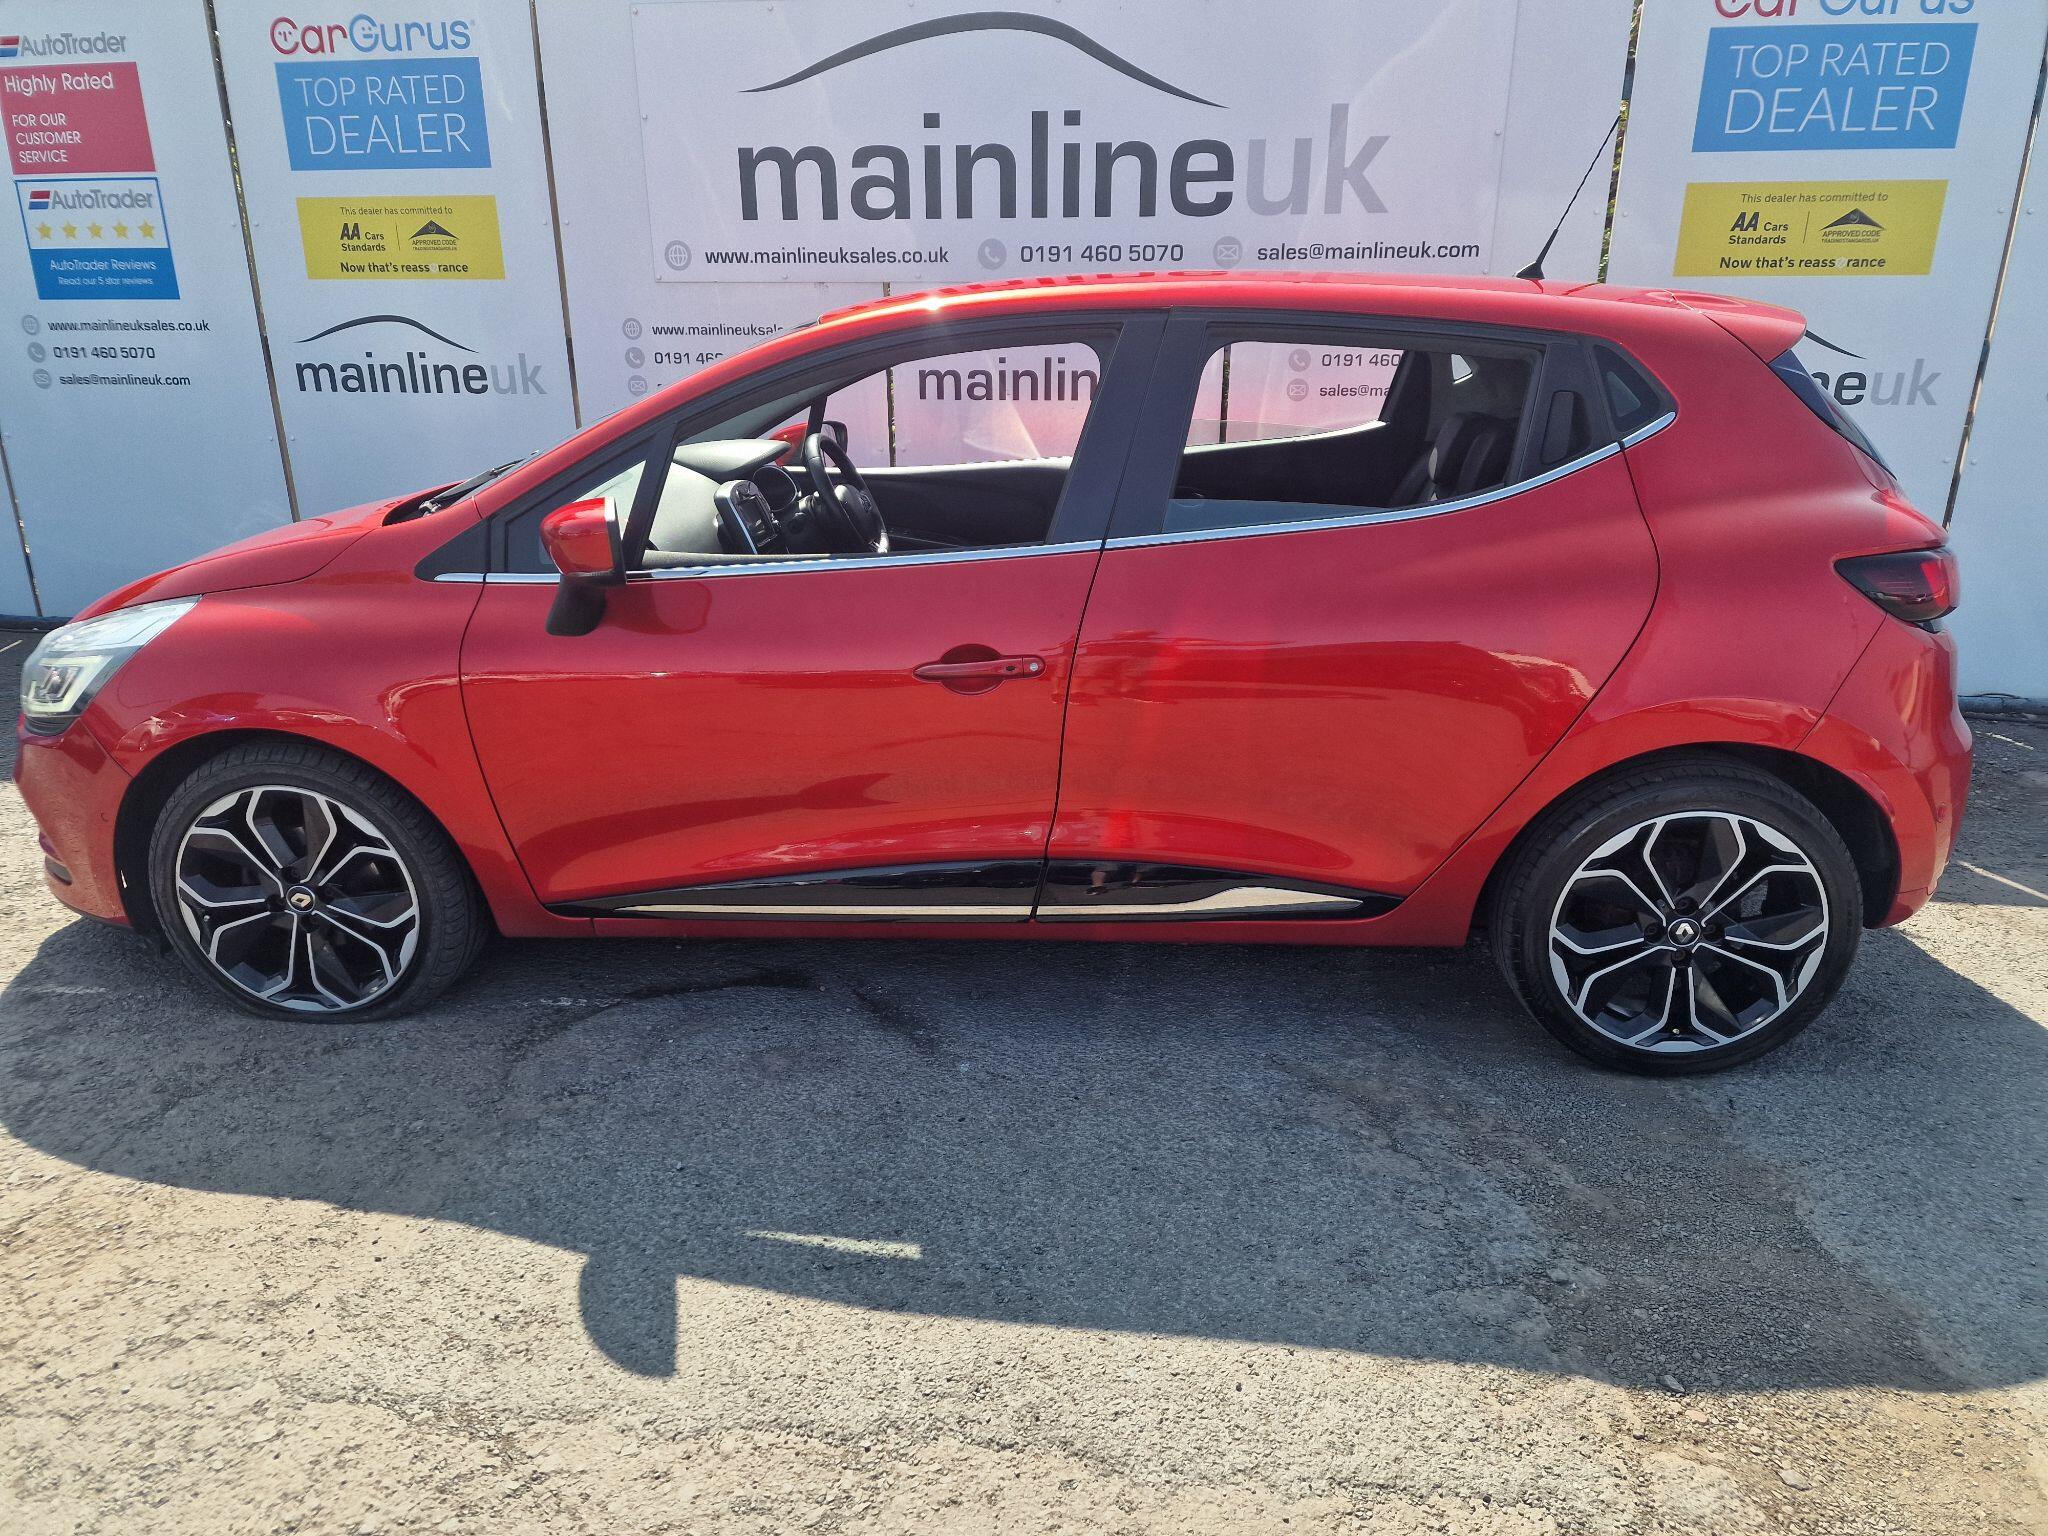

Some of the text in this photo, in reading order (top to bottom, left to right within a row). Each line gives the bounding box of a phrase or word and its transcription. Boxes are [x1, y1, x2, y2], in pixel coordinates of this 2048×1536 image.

[269, 13, 472, 55] CarGurus
[20, 31, 127, 57] AutoTrader
[1729, 42, 1950, 78] TOP RATED
[4, 71, 114, 96] Highly Rated
[294, 74, 465, 107] TOP RATED
[1723, 85, 1939, 134] DEALER
[12, 112, 66, 127] FOR OUR
[15, 131, 83, 145] CUSTOMER
[305, 112, 471, 155] DEALER
[19, 149, 68, 164] SERVICE
[737, 102, 1391, 221] mainlineuk
[50, 188, 153, 210] AutoTrader
[1741, 191, 1889, 204] This dealer has committed to
[339, 204, 453, 217] This dealer has committed to
[1730, 211, 1789, 232] AA Cars
[339, 222, 385, 241] AA Cars
[1822, 229, 1881, 238] APPROVED CODE
[340, 242, 386, 252] Standards
[1728, 234, 1787, 245] Standards
[704, 246, 950, 265] www.mainlineuksales.co.uk
[1020, 244, 1184, 263] 0191 460 5070
[1256, 241, 1480, 261] sales@mainlineuk.com
[49, 259, 157, 272] AutoTrader Reviews
[339, 261, 365, 273] Now
[401, 262, 470, 273] reassrance
[1719, 256, 1886, 269] Now that's reassrance
[58, 276, 81, 286] Read
[122, 276, 154, 286] reviews
[48, 319, 210, 332] www.mainlineuksales.co.uk
[53, 347, 156, 359] 0191 460 5070
[654, 352, 691, 365] 0191
[1321, 353, 1401, 367] 0191 460
[59, 372, 191, 386] sales@mainlineuk.com
[294, 351, 549, 395] mainlineuk
[918, 356, 1099, 401] mainlin
